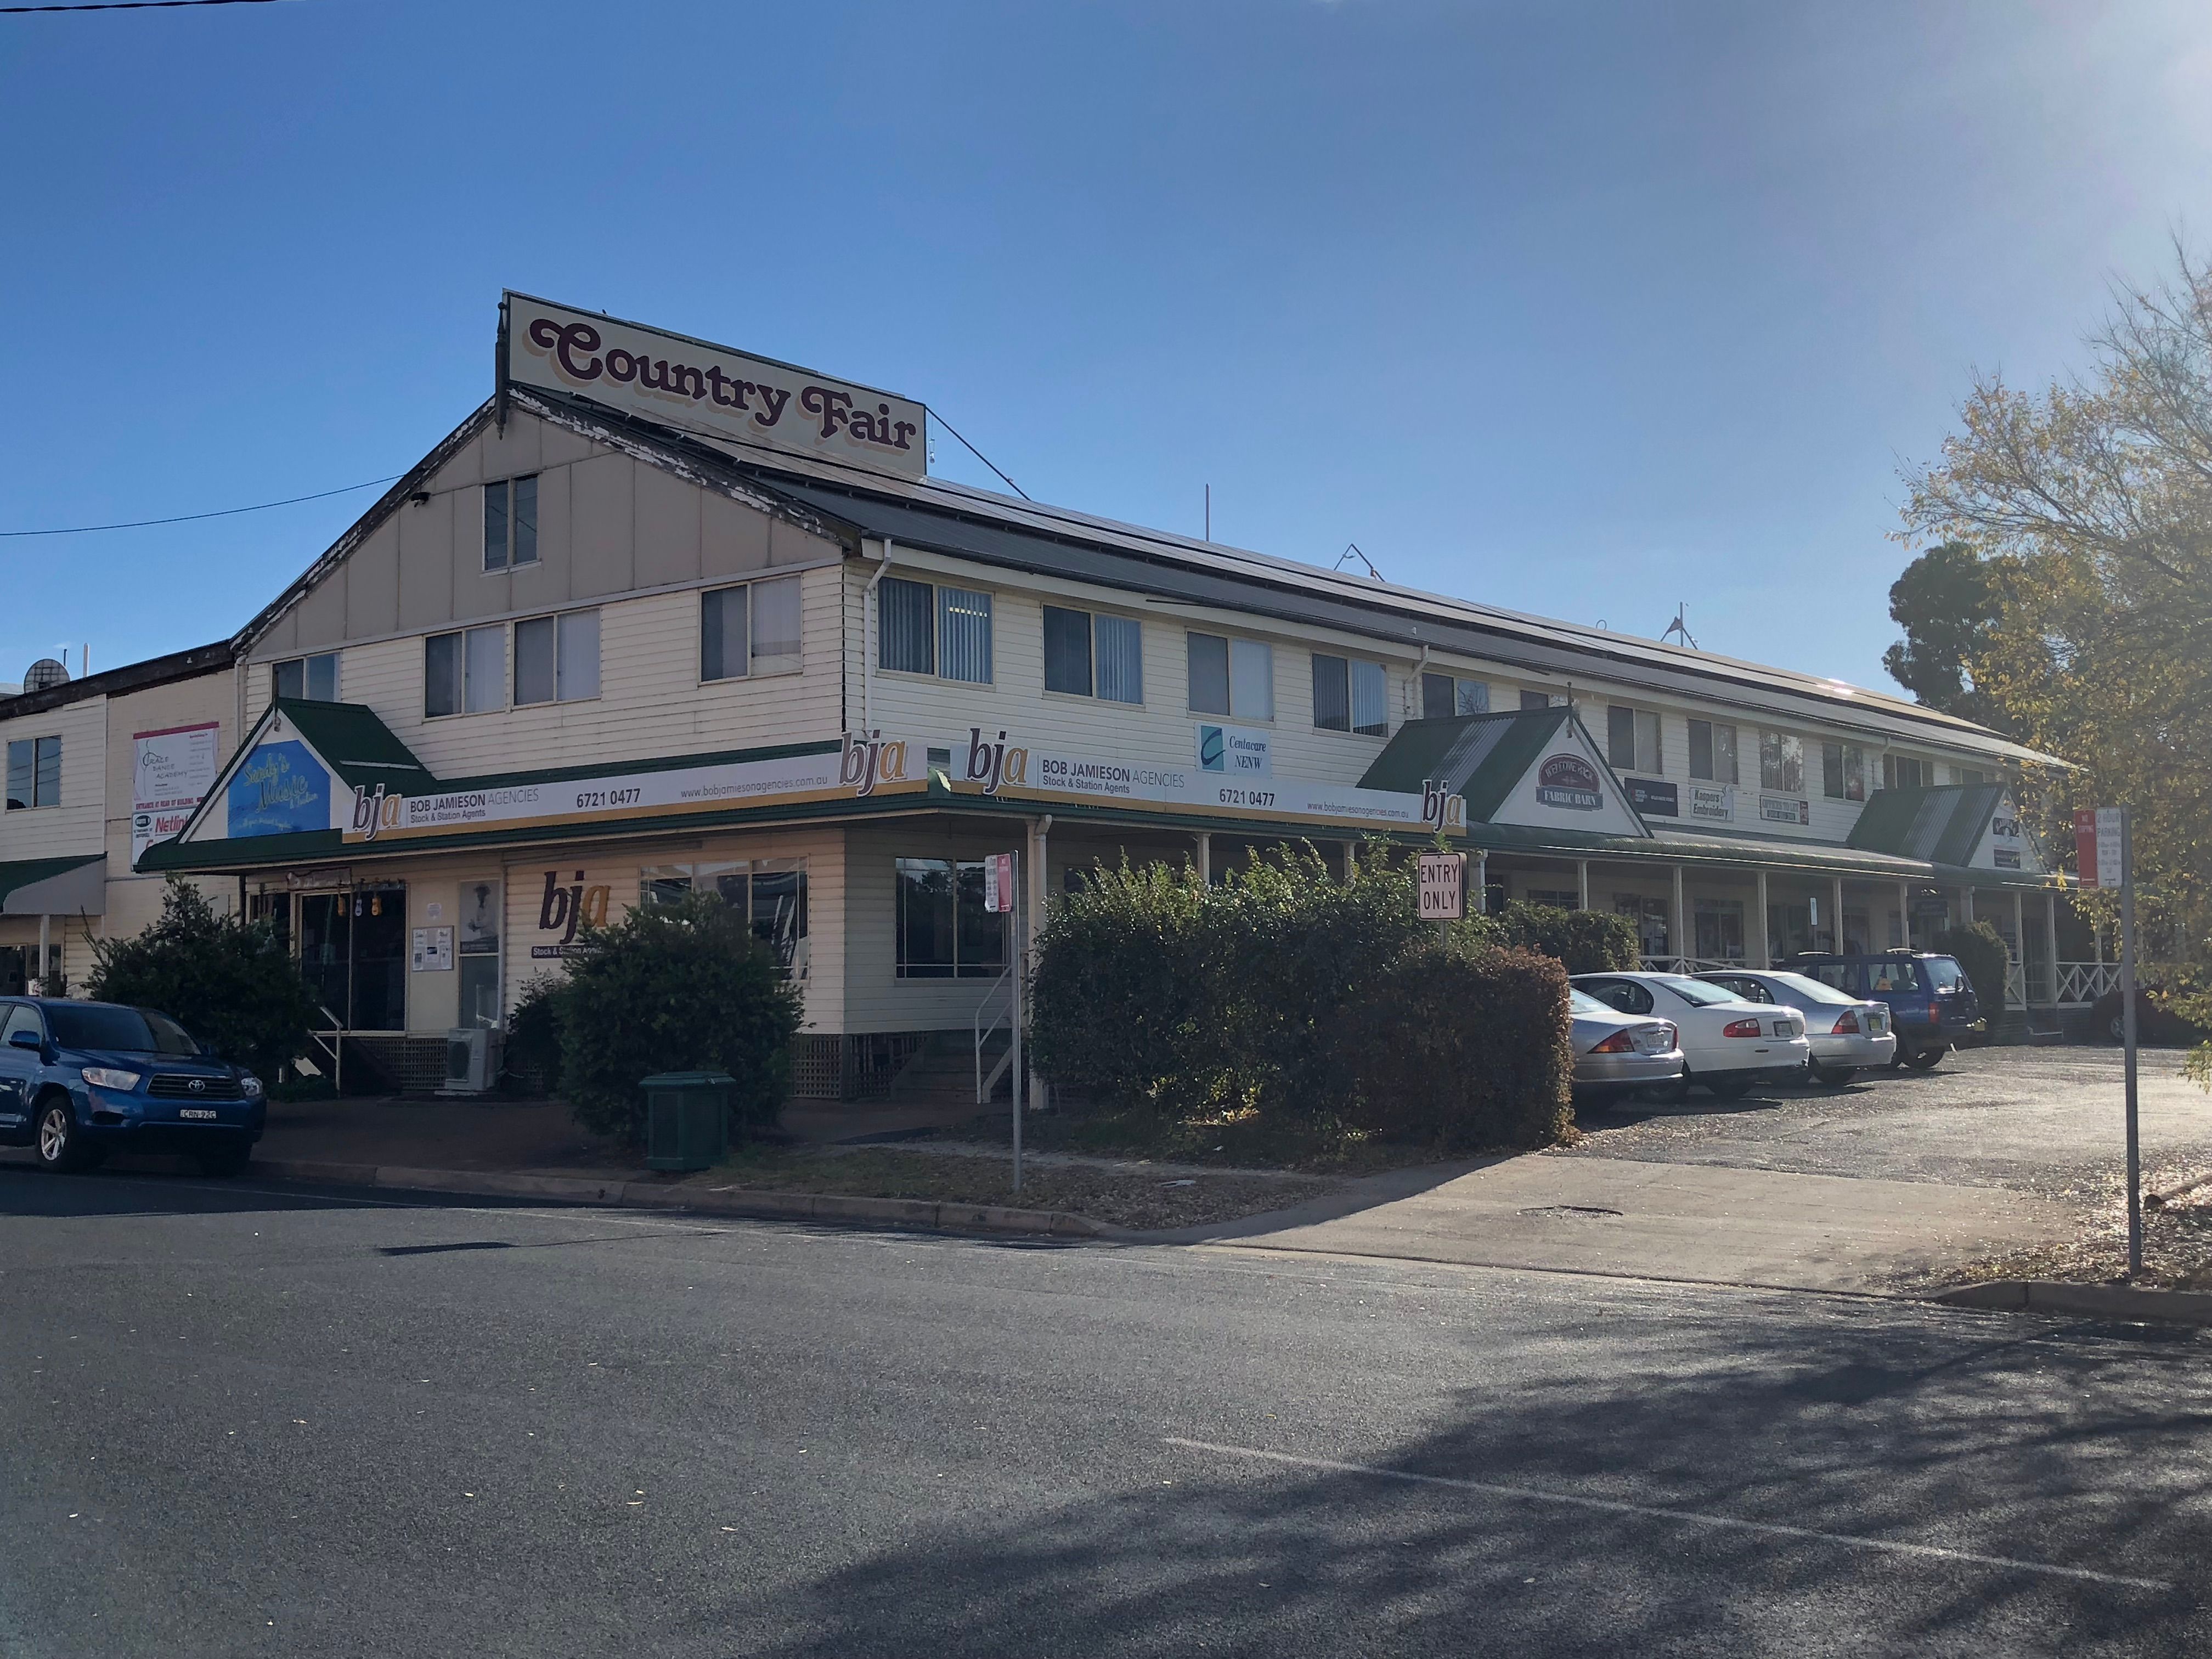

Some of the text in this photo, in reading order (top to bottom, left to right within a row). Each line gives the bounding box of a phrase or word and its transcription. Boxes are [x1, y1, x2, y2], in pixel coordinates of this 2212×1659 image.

[529, 318, 916, 450] Country Fair
[1229, 736, 1267, 752] Centacare
[244, 753, 290, 786] Sandy's
[840, 730, 906, 794] bja
[967, 728, 1028, 794] bja
[1235, 755, 1262, 770] NENW
[1043, 760, 1184, 788] BOB JAMIESON AGENCIES
[255, 775, 308, 813] Music
[681, 776, 828, 798] www.bobjamiesonagencies.com.au
[1043, 775, 1130, 794] Stock & Station Agents
[410, 788, 539, 813] BOB JAMIESON AGENCIES
[577, 788, 641, 808] 6721 0477
[1220, 788, 1275, 806] 6721 0477
[1423, 780, 1462, 832] bja
[1544, 790, 1596, 806] FABRIC BARN
[1695, 789, 1719, 804] Kaspers
[353, 785, 401, 840] bja
[410, 808, 486, 823] Stock & Station Agents
[1307, 802, 1409, 819] www.bobjamiesonagencies.com.au
[1694, 804, 1729, 820] Embroidery
[2097, 813, 2119, 823] 2 HOUR
[2097, 827, 2120, 837] PARKING
[1421, 864, 1457, 883] ENTRY
[539, 871, 611, 944] bja
[1424, 891, 1456, 911] ONLY
[533, 947, 551, 956] Stock
